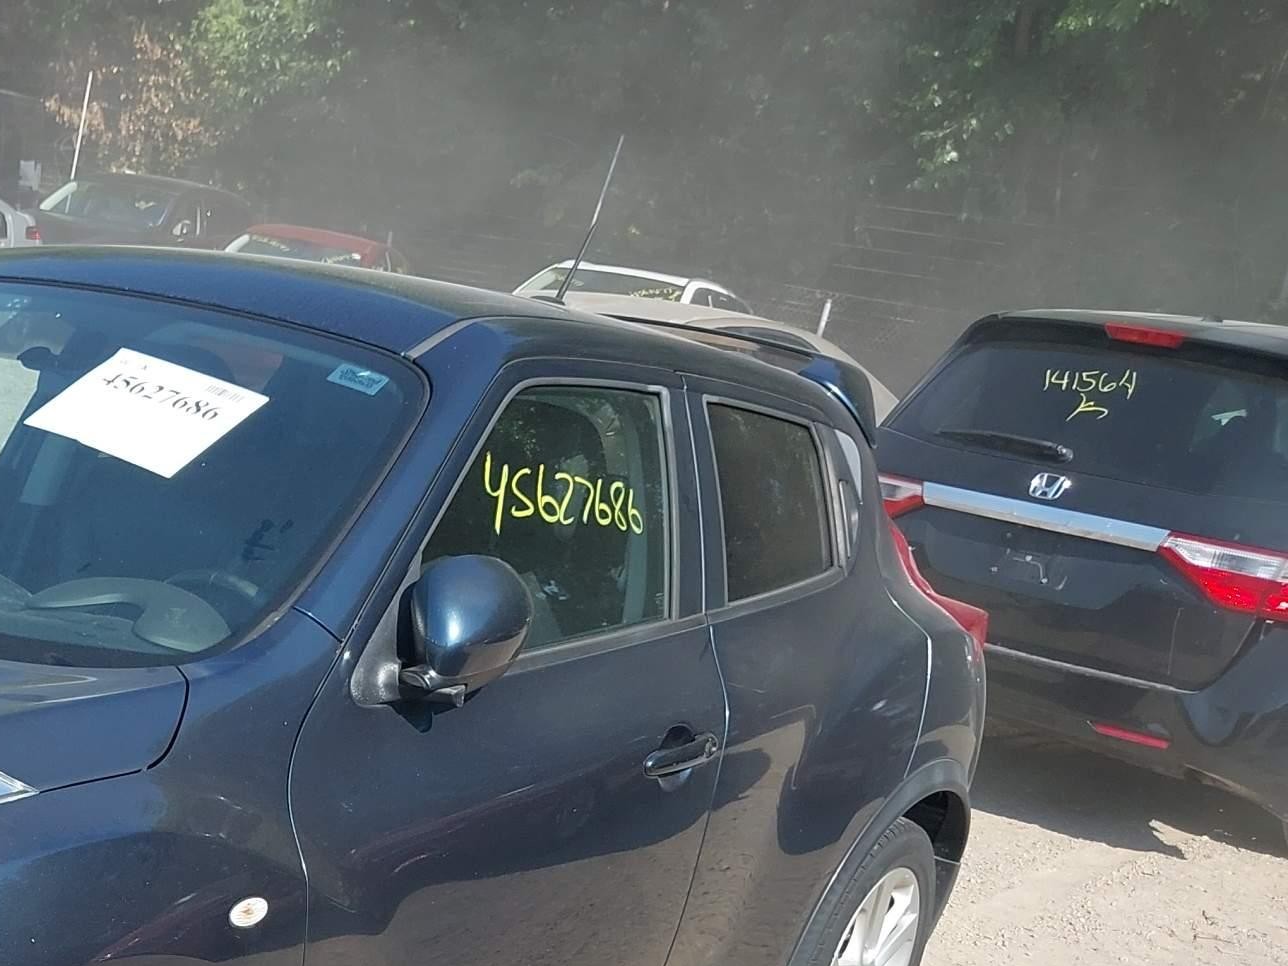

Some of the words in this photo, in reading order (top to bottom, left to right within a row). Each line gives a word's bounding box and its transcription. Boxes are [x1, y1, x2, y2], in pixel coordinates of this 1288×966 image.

[103, 373, 223, 420] 45627686
[1043, 369, 1137, 400] 141564
[484, 451, 644, 536] 45627686
